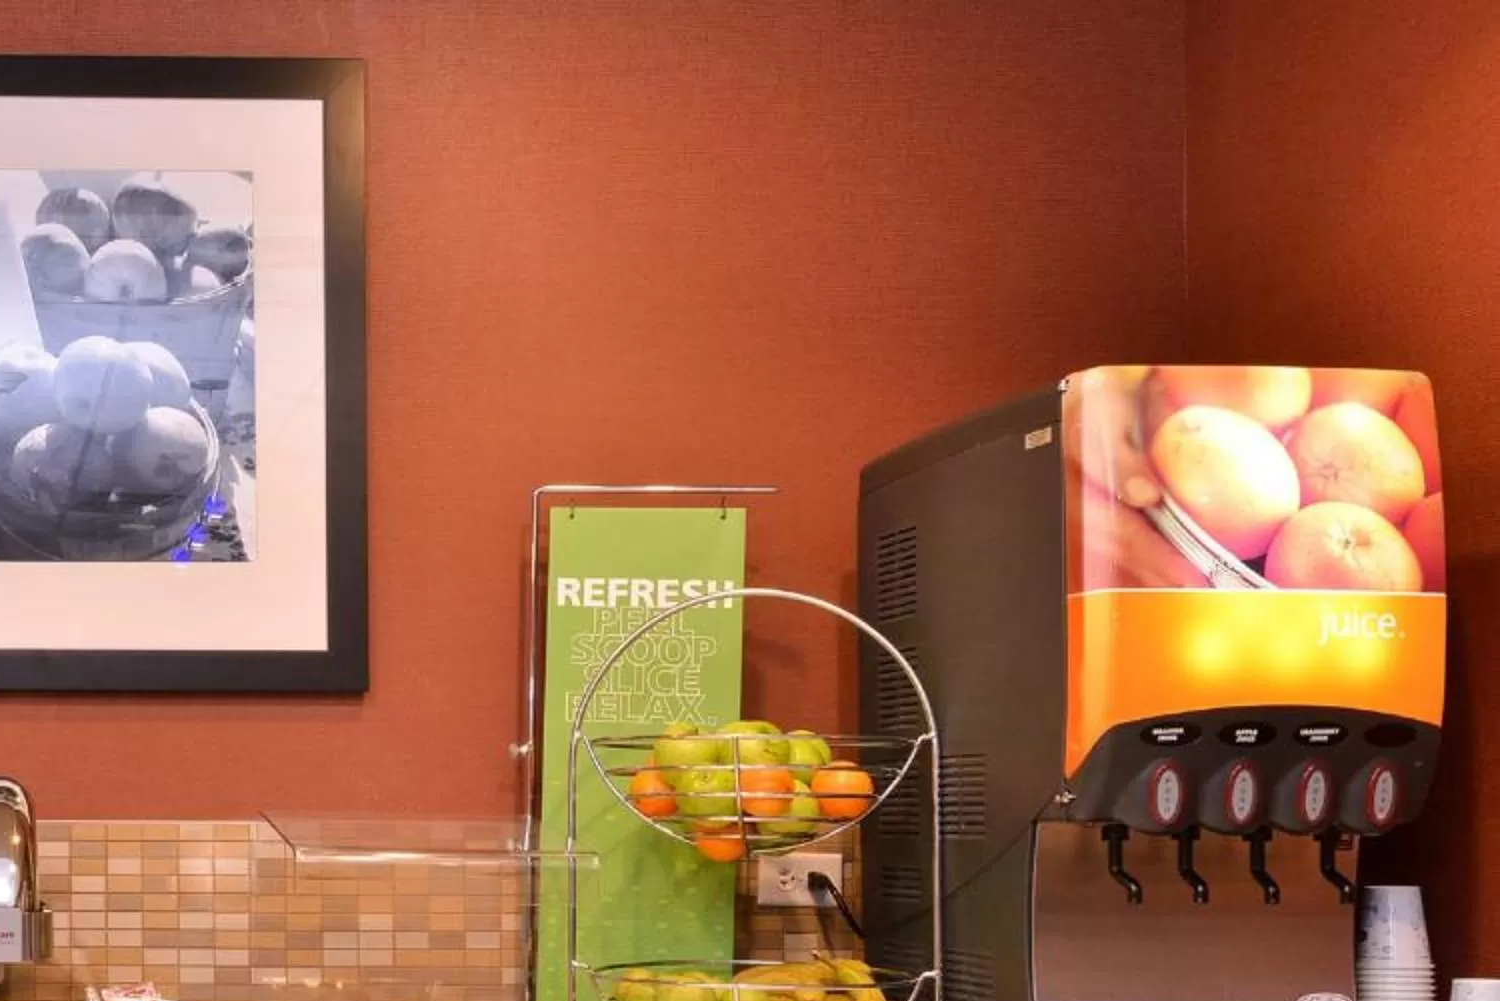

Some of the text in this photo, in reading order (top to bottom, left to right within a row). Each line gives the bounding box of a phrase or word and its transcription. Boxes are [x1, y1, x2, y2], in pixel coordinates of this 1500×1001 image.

[556, 577, 735, 609] REFRESH
[593, 606, 696, 638] PEEL
[570, 633, 717, 669] SCOOP
[583, 663, 701, 697] SLICE
